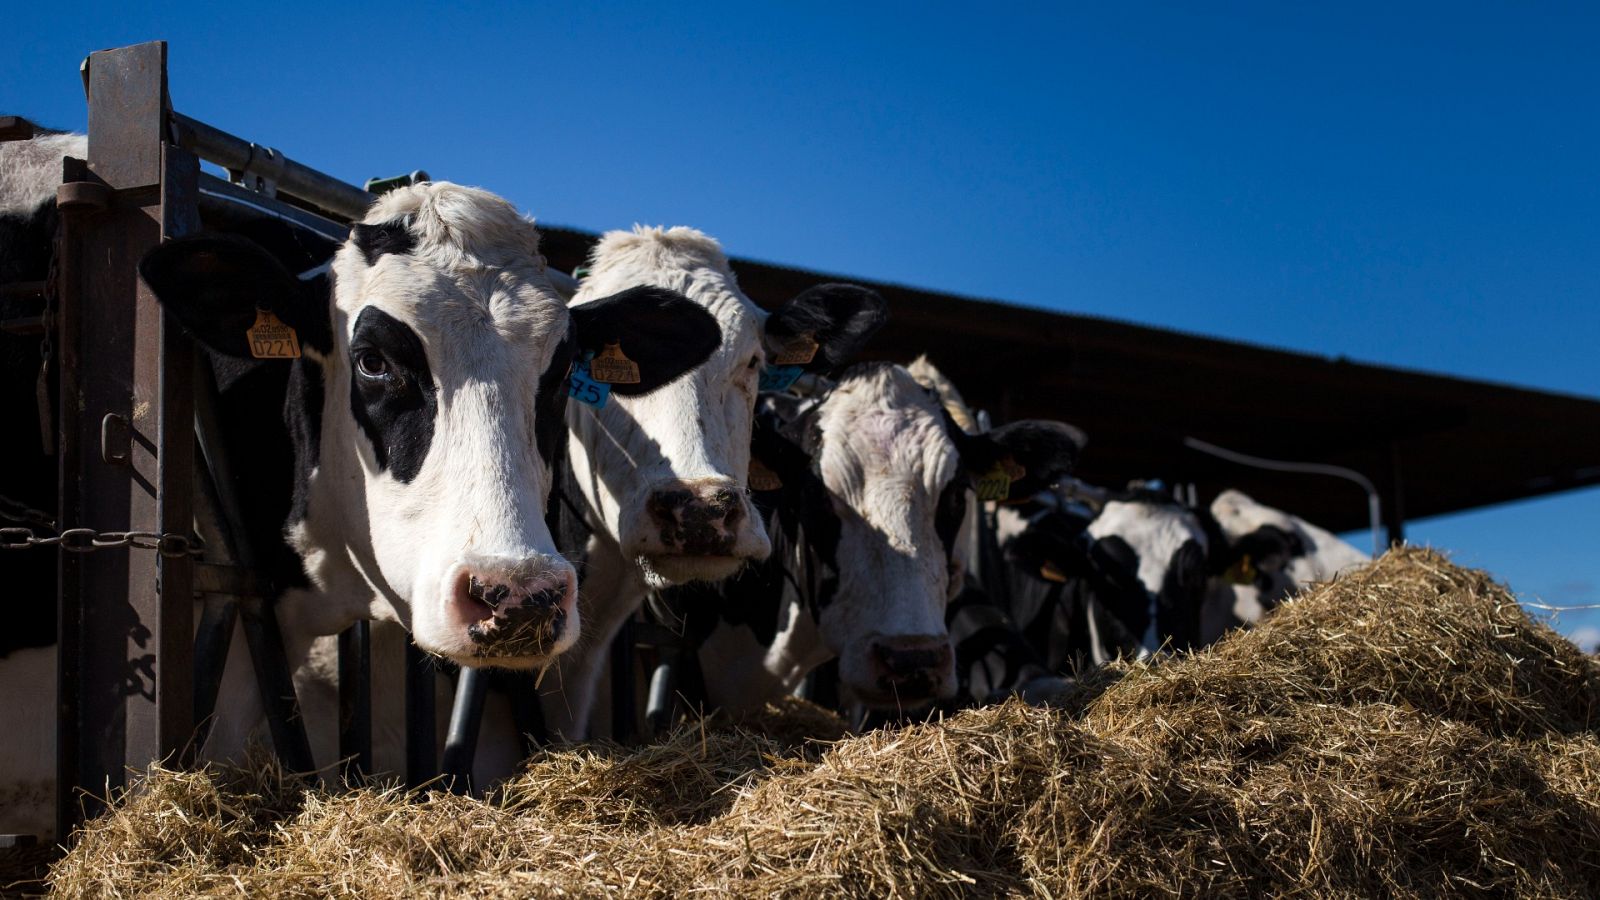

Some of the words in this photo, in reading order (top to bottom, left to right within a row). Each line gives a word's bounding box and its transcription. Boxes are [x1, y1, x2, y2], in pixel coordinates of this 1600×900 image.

[253, 340, 296, 356] 0221
[595, 368, 637, 381] 0221
[571, 376, 601, 404] 75
